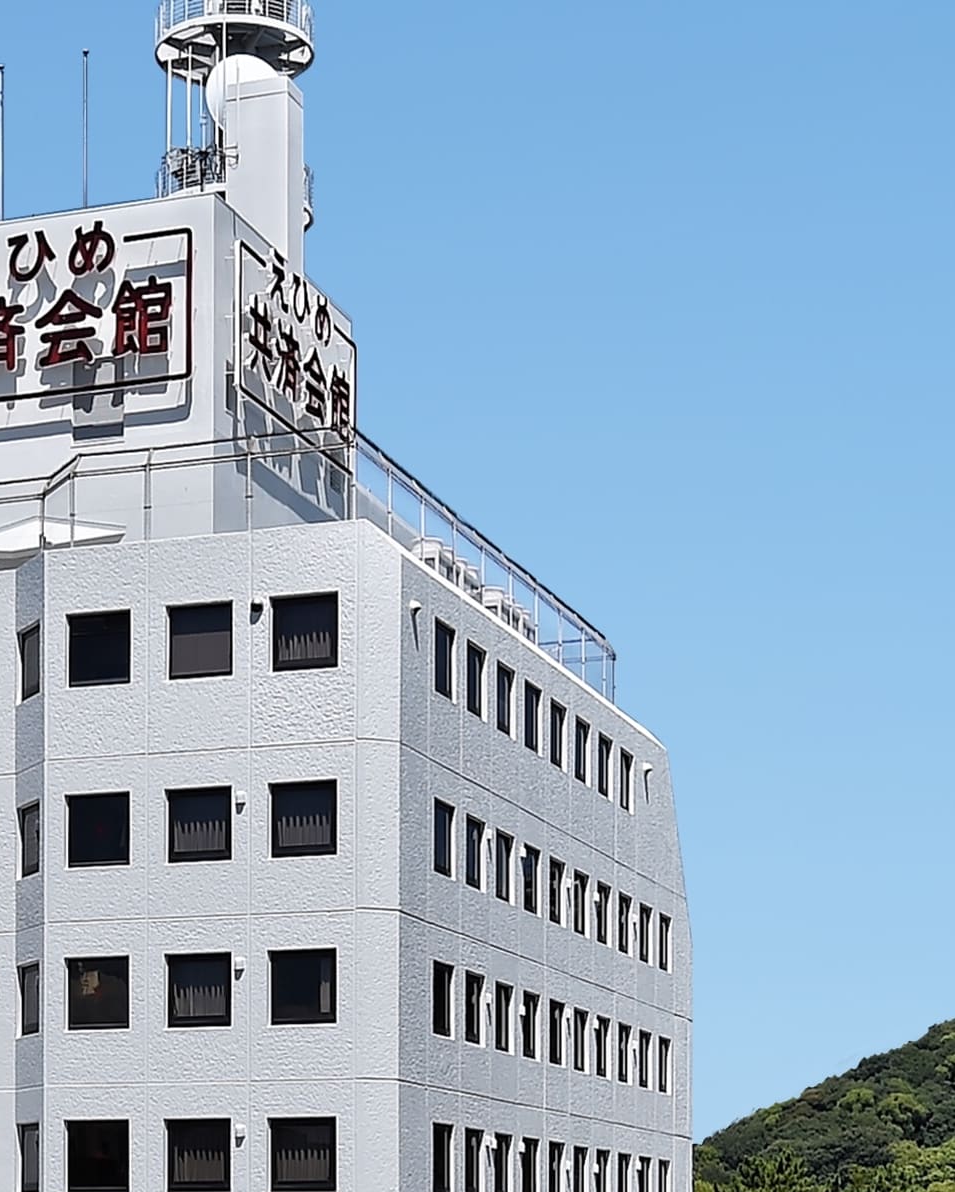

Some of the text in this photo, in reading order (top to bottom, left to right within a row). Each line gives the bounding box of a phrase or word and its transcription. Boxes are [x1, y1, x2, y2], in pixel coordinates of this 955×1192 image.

[272, 249, 331, 347] えひめ
[249, 294, 350, 442] 共済会館
